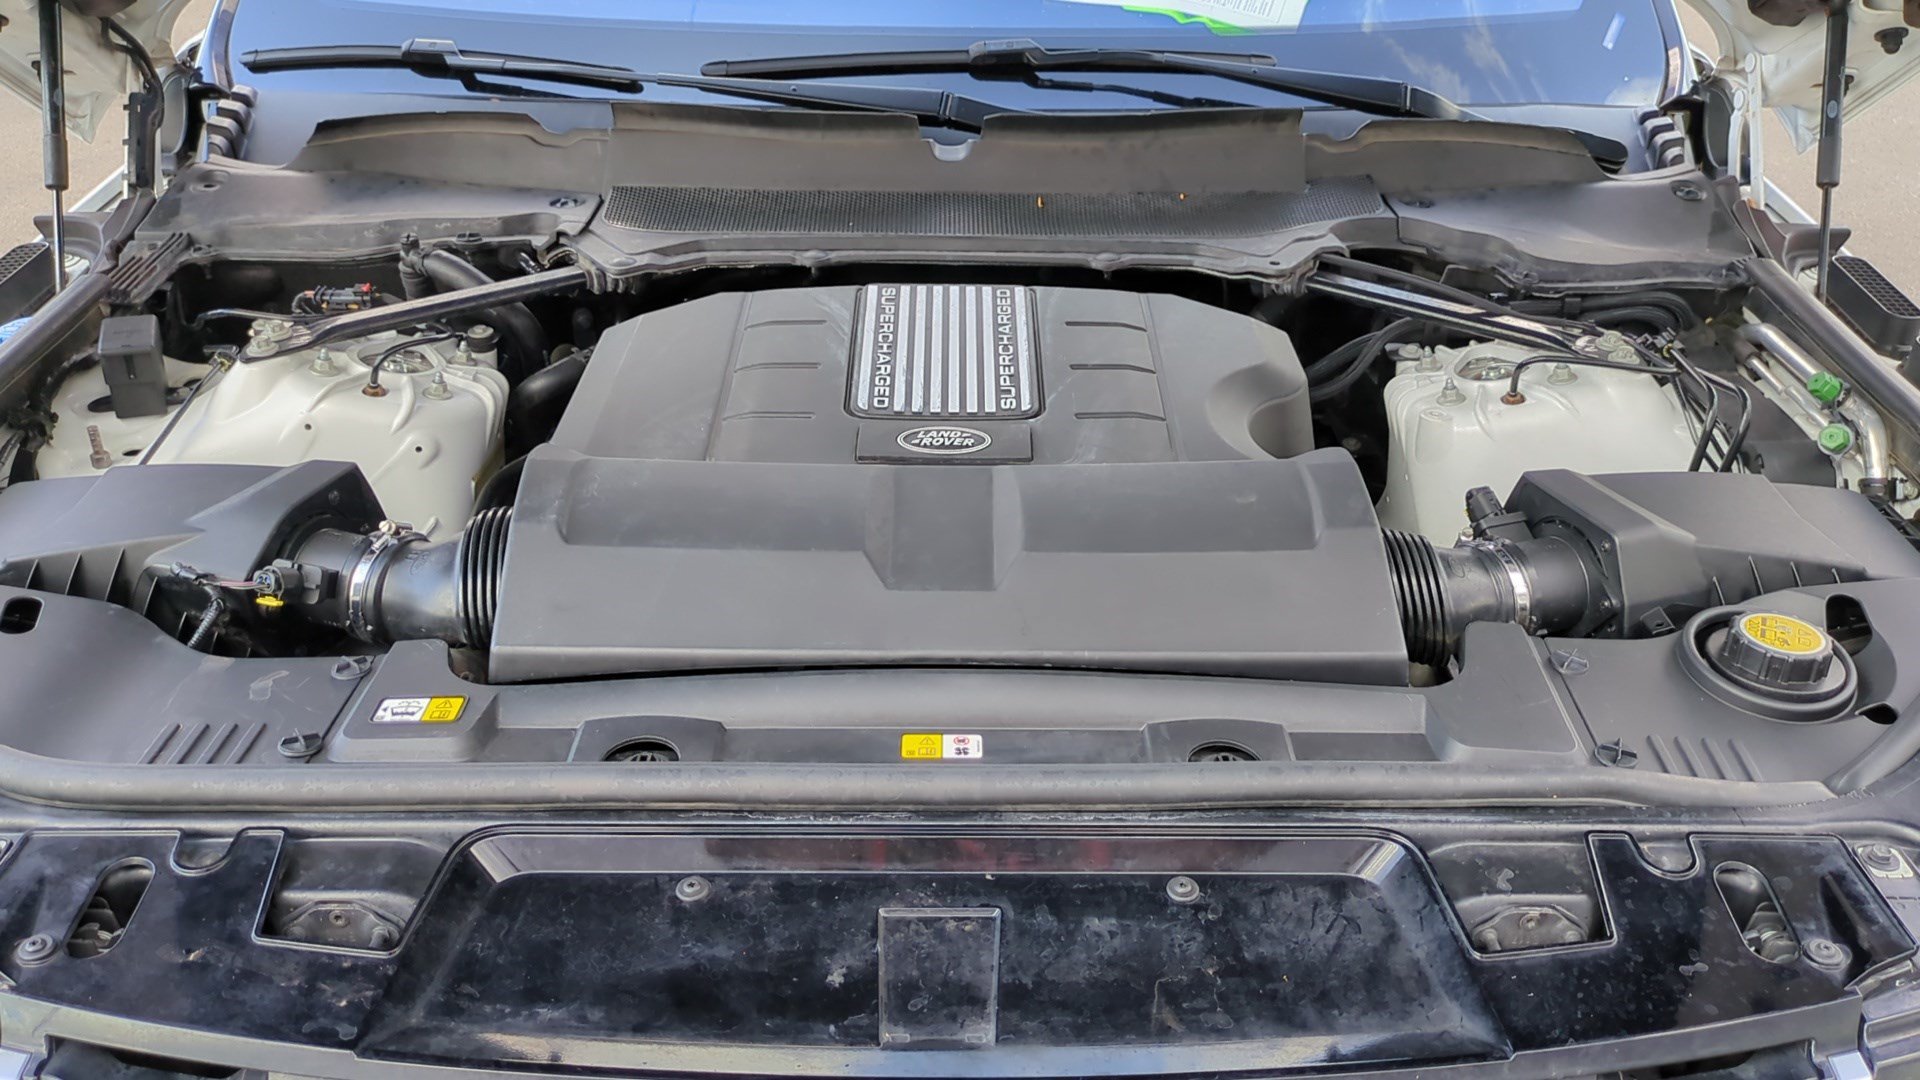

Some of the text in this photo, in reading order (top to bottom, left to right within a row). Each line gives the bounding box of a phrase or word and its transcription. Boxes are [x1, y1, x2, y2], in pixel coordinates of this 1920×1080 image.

[873, 287, 896, 409] SUPERCHARGED
[996, 288, 1017, 410] SUPERCHARGED
[917, 430, 962, 439] LAND
[919, 437, 975, 447] ROVER
